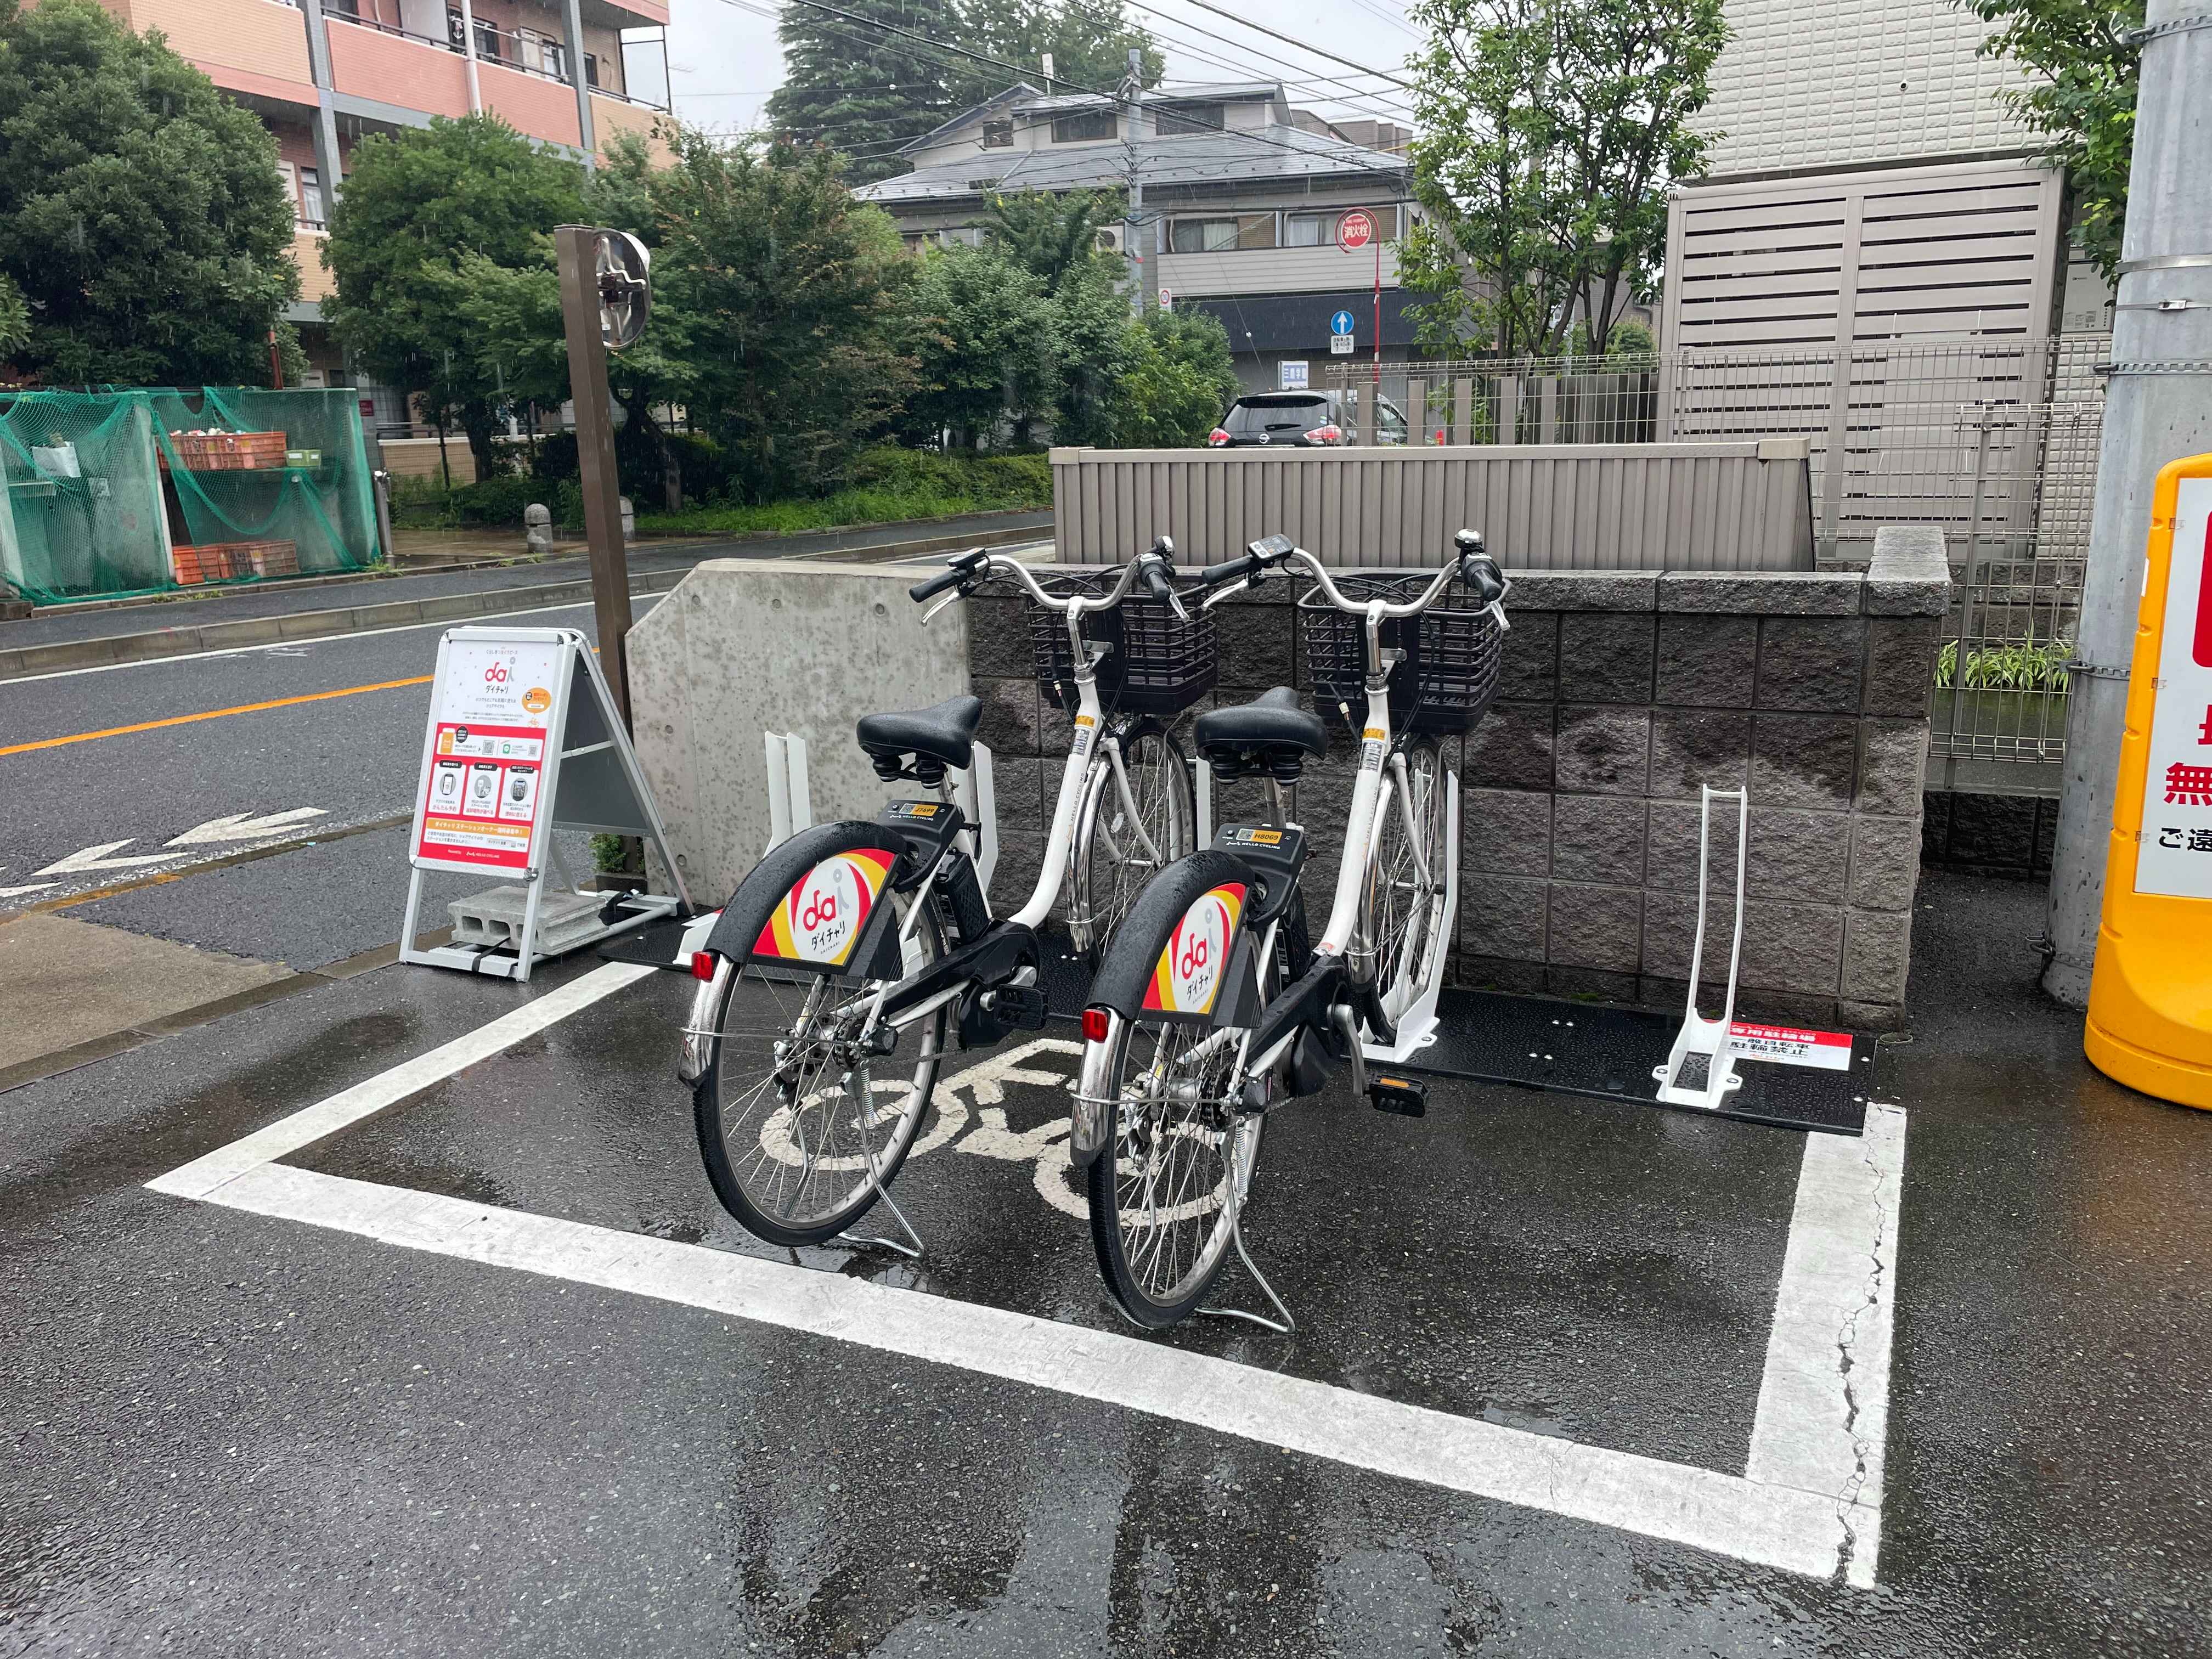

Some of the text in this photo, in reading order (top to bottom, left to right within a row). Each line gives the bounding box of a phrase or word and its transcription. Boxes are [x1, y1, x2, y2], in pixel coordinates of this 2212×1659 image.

[1344, 223, 1368, 239] 消火栓
[486, 685, 509, 694] ダイチャリ
[811, 920, 845, 951] ダイチャリ
[1187, 964, 1212, 1001] ダイチャリ
